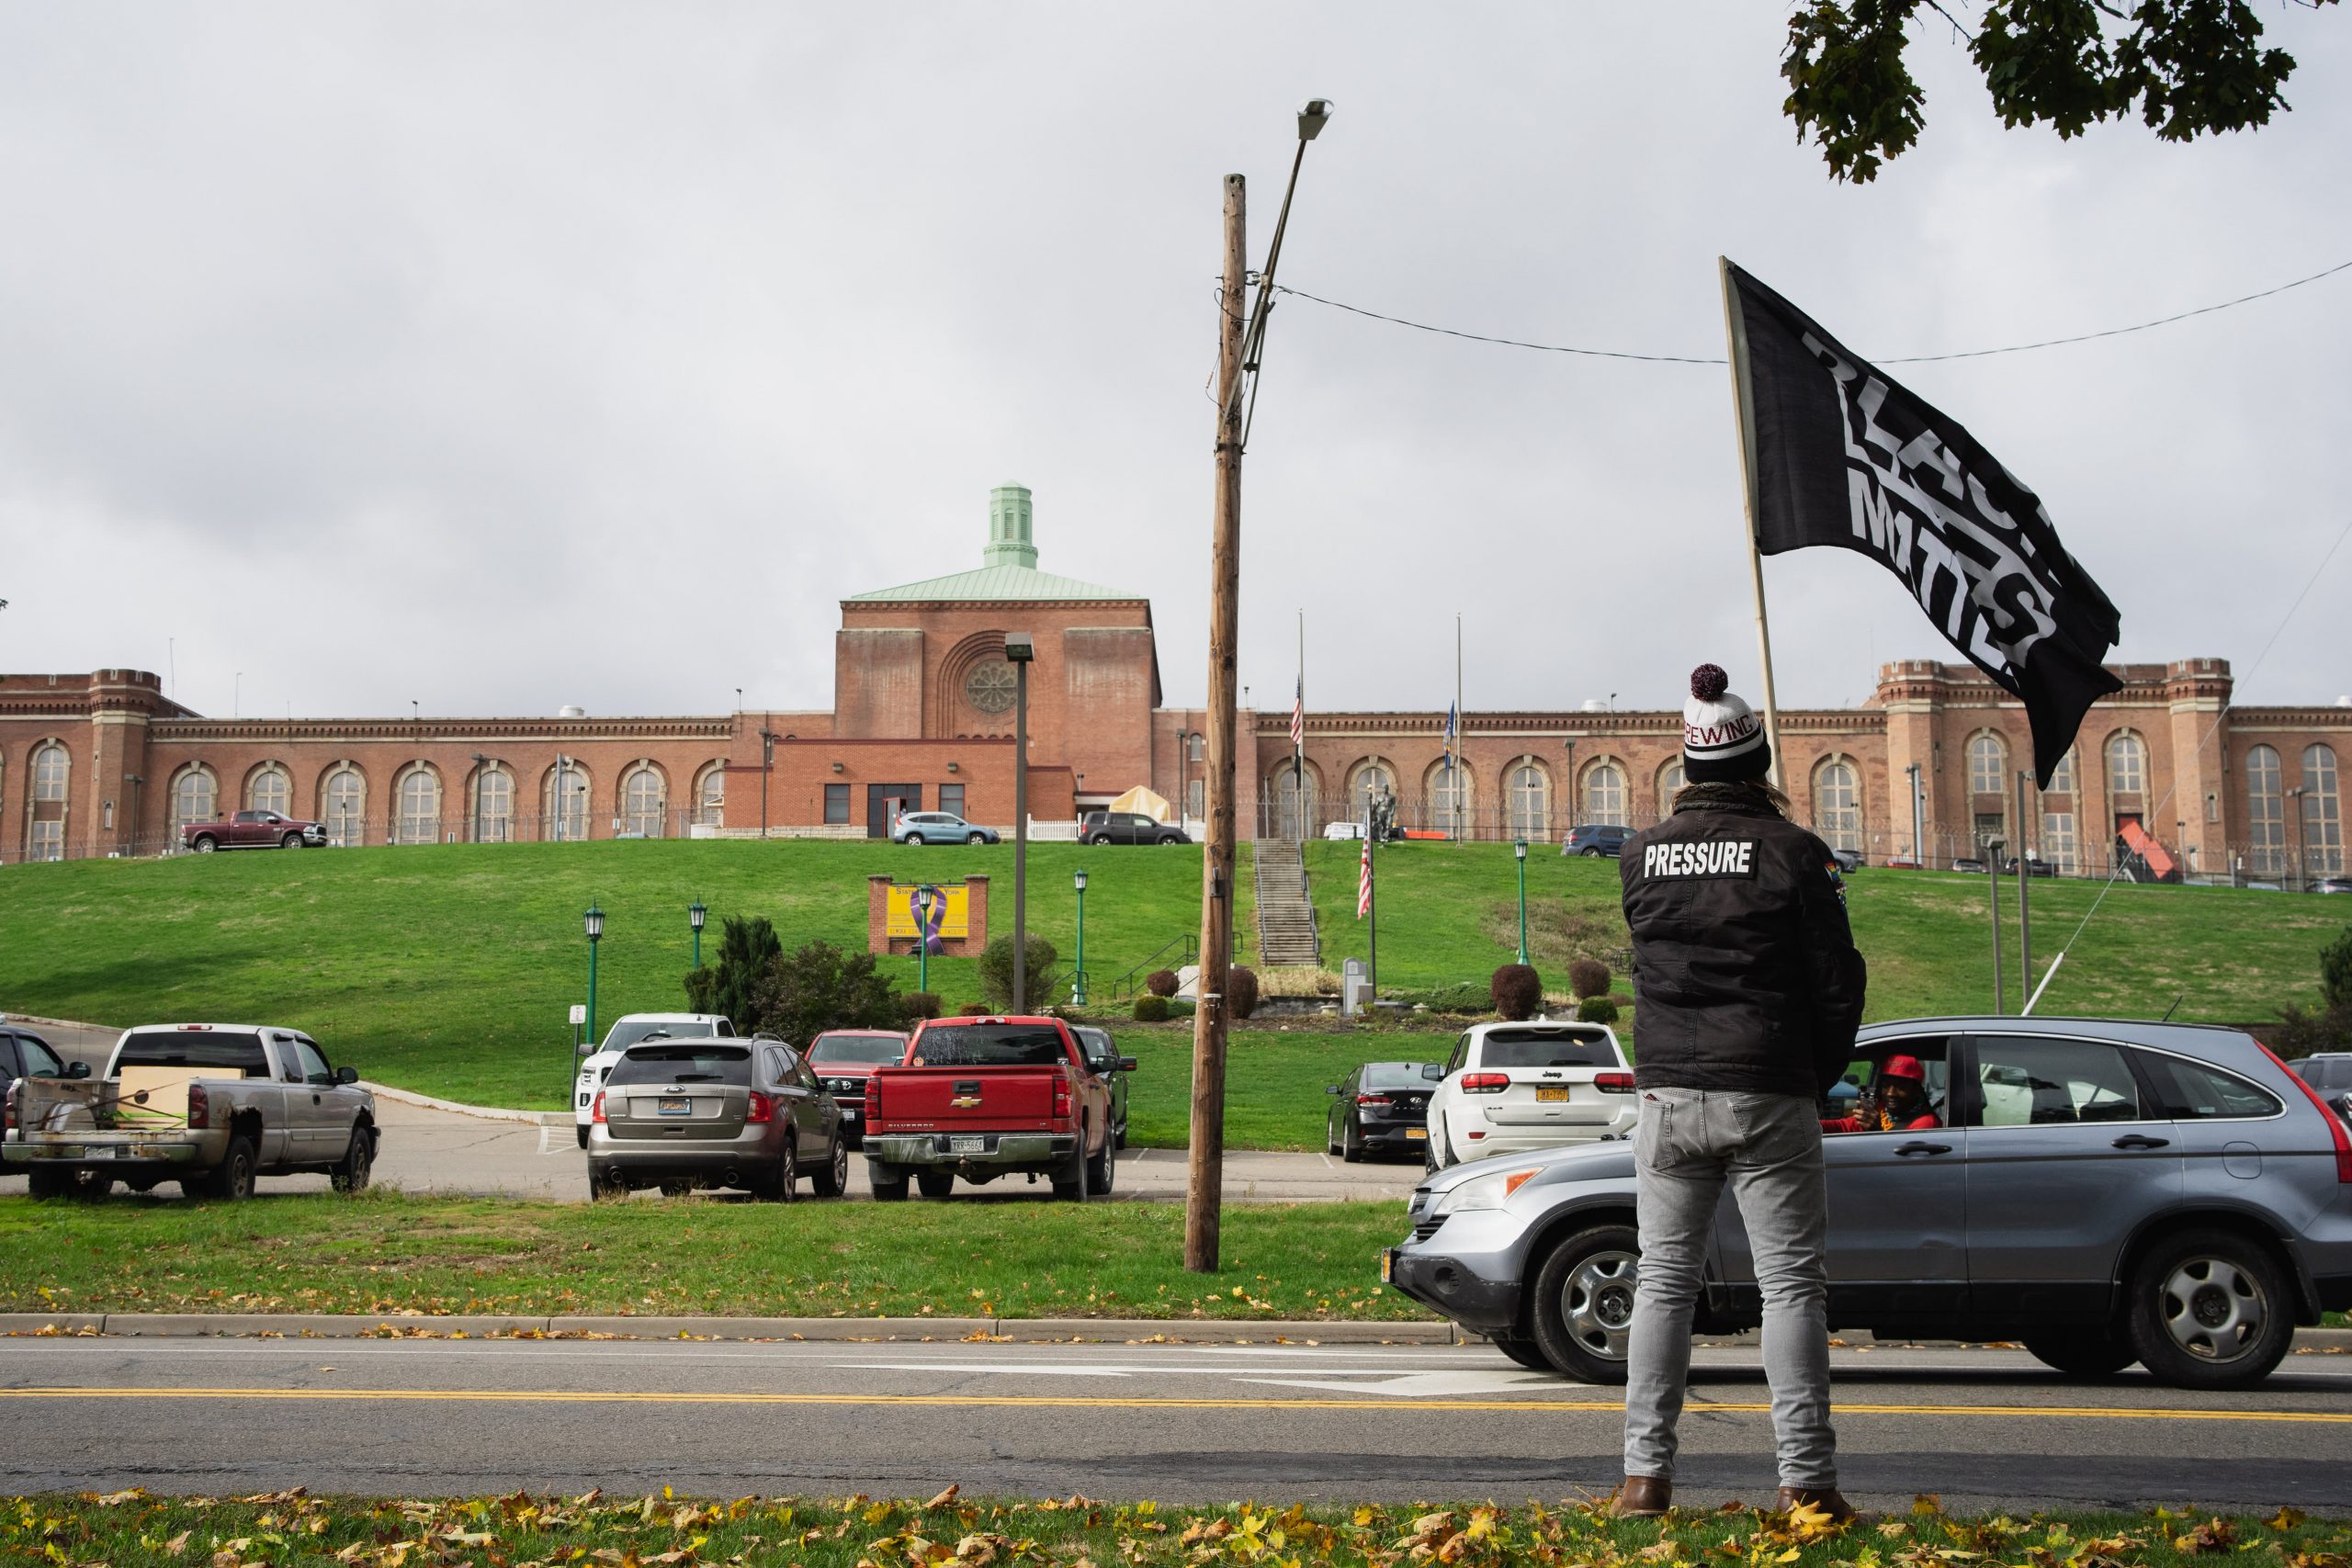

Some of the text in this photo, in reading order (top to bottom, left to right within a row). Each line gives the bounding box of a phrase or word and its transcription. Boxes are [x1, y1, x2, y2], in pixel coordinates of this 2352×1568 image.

[1802, 331, 2075, 588] BLAC
[1847, 467, 2020, 689] MATTE
[1644, 841, 1753, 878] PRESSURE
